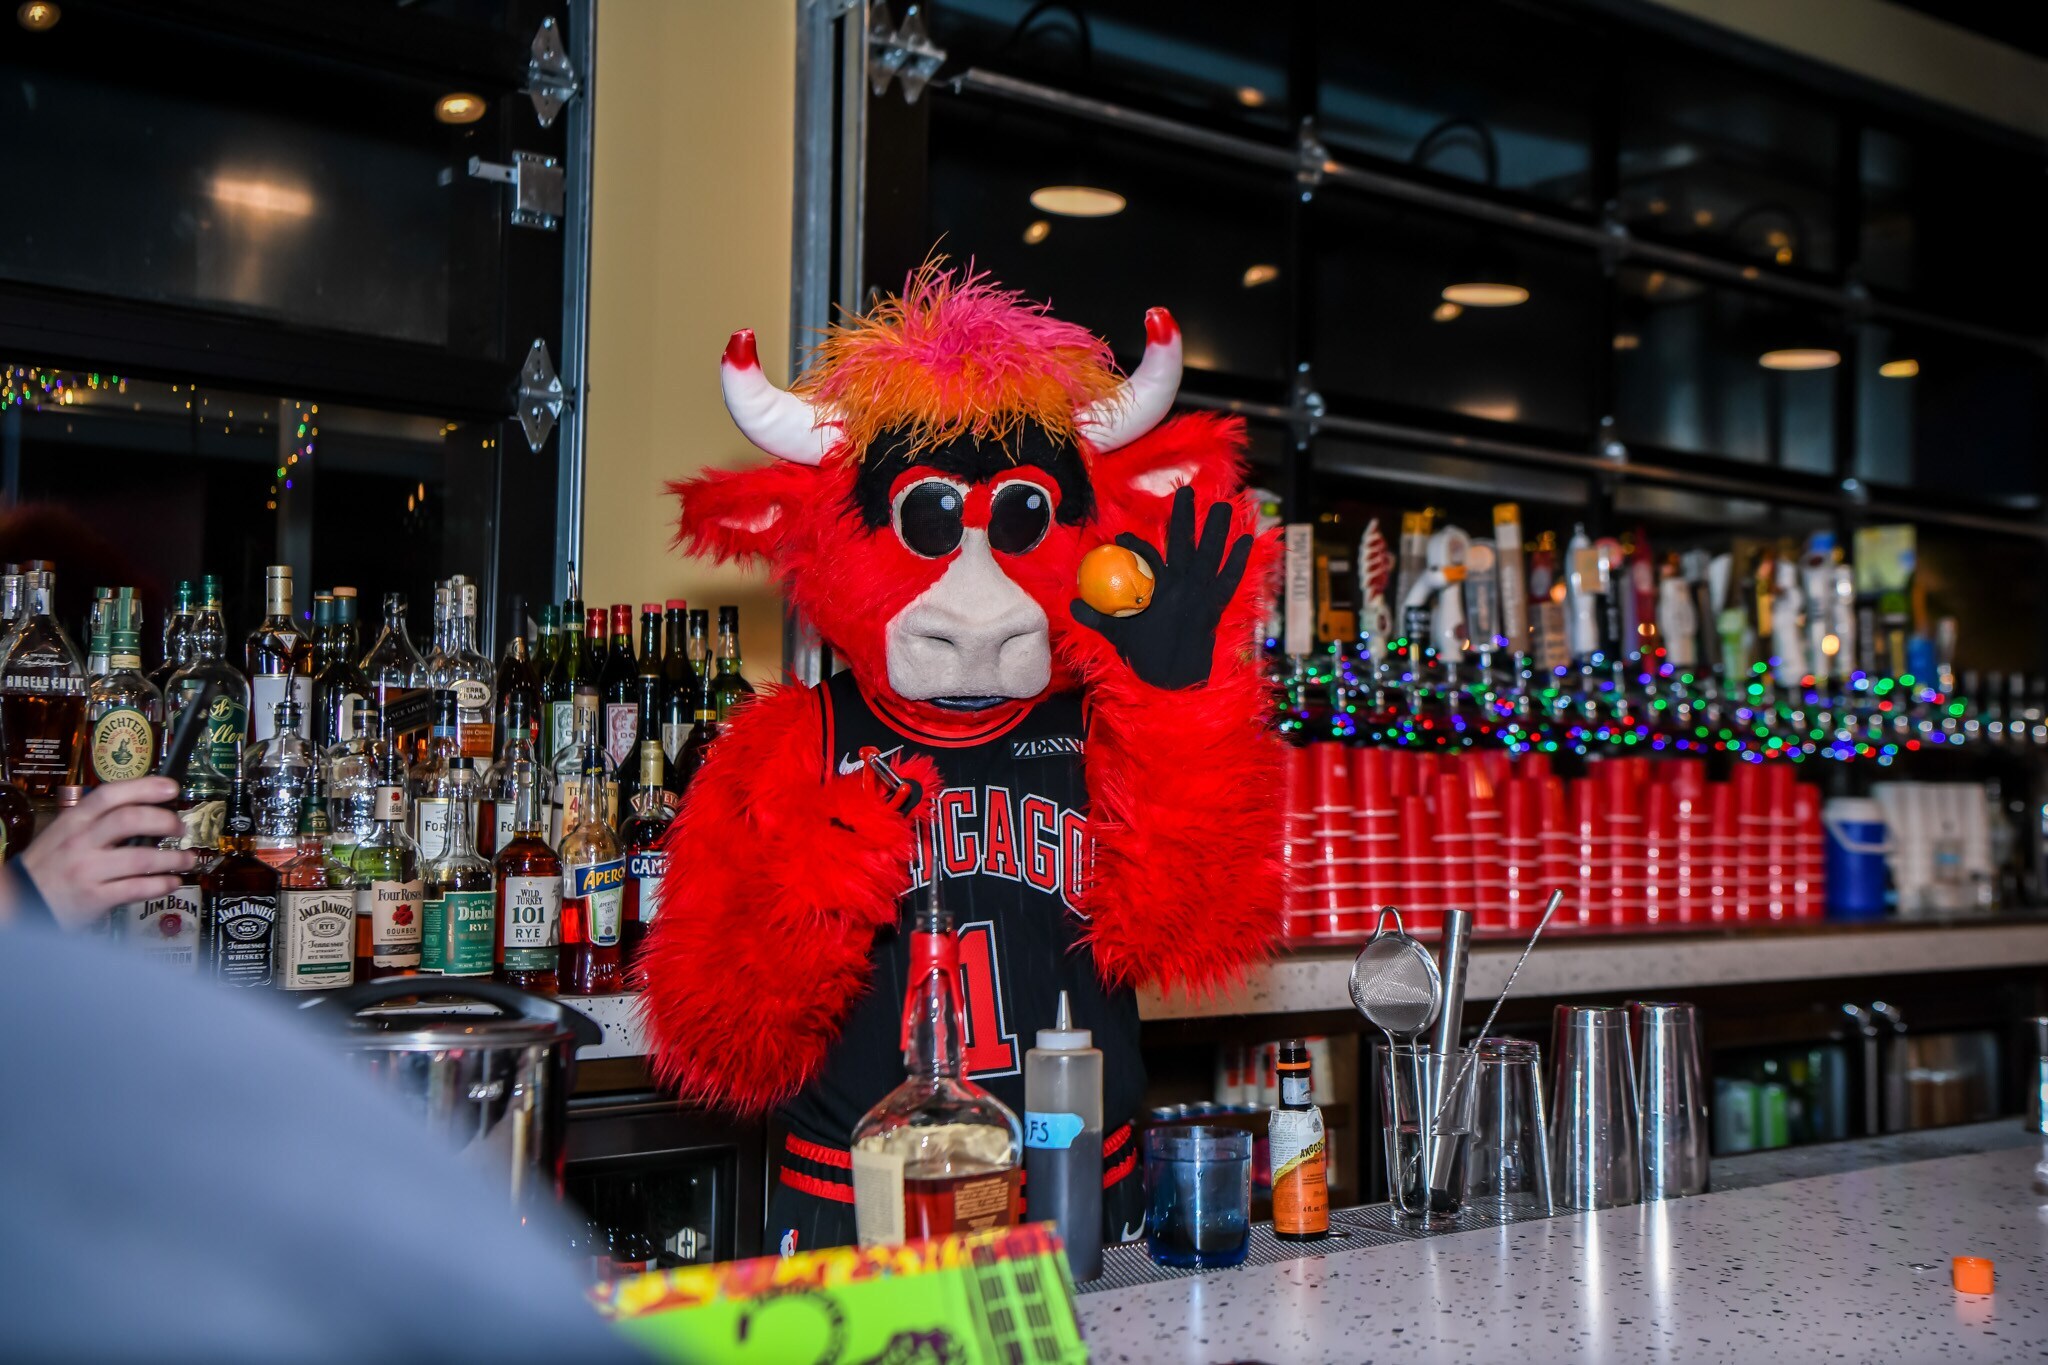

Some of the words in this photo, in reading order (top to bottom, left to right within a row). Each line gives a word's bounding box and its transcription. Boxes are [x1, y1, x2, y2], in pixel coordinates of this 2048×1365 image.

[51, 677, 82, 690] ENVY
[98, 716, 148, 746] MICHTER'S
[1014, 737, 1084, 757] ZENNI
[98, 756, 134, 778] STRAIGHT
[134, 755, 146, 771] RYE
[903, 785, 1094, 920] ICAGO
[378, 888, 400, 901] Four
[400, 888, 422, 901] Roses
[516, 896, 543, 905] TURKEY
[520, 888, 540, 898] WILD
[140, 898, 164, 920] JIM
[167, 895, 198, 918] BEAM
[218, 904, 241, 923] JACK
[241, 900, 276, 922] DANIEL'S
[298, 904, 321, 922] JACK
[322, 900, 353, 920] DANIEL'S
[512, 906, 545, 924] 101
[386, 928, 416, 936] BOURBON
[469, 924, 490, 932] RYE
[516, 928, 540, 938] RYE
